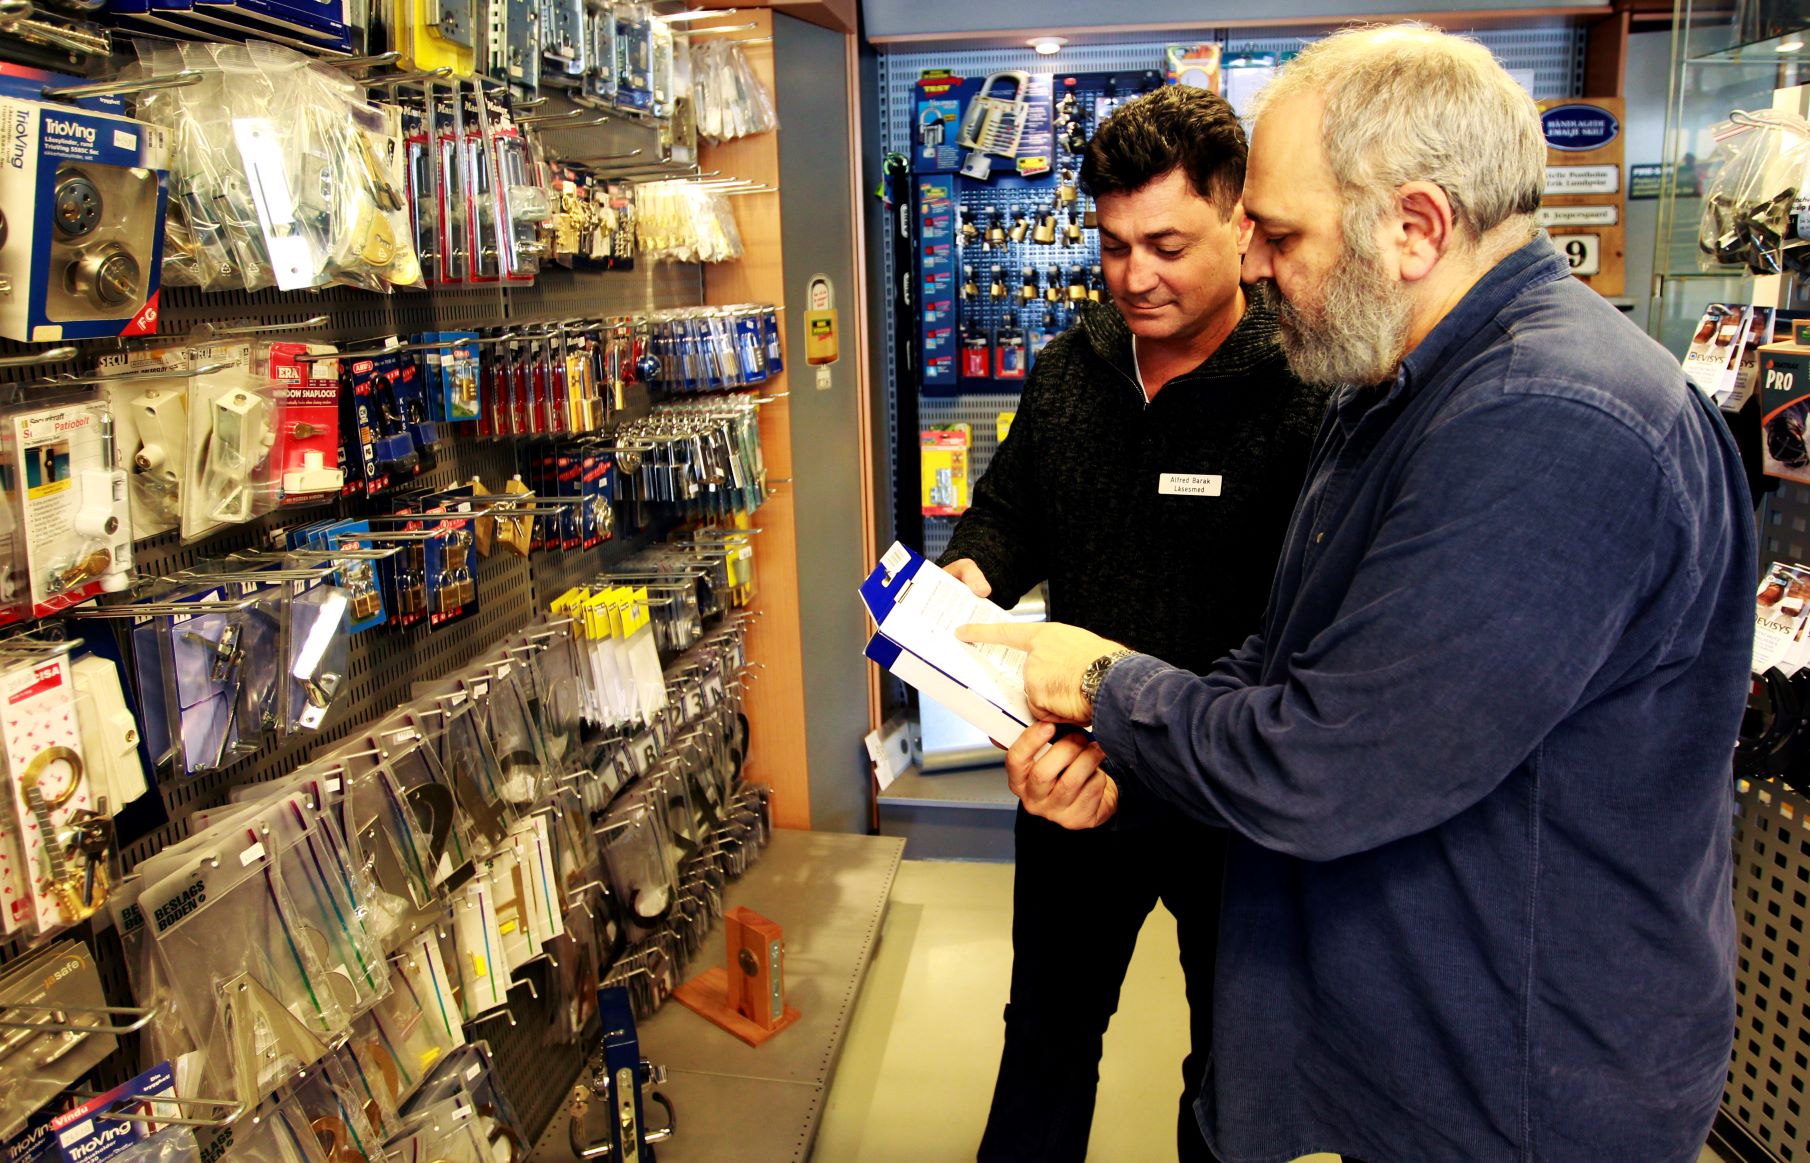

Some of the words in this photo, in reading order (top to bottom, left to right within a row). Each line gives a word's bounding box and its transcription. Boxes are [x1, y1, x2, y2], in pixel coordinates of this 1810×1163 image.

[11, 110, 29, 169] TrioVing
[45, 118, 96, 142] TrioVing
[1566, 240, 1587, 268] 9
[136, 307, 157, 331] FG
[1688, 352, 1726, 364] DEVISYS
[278, 367, 299, 379] ERA
[1765, 369, 1794, 391] PRO
[302, 389, 337, 398] SNAPLOCKS
[1170, 476, 1190, 484] Alfred
[154, 879, 205, 921] BESLAGS
[157, 899, 198, 932] BODEN
[54, 1105, 89, 1127] Vindu
[69, 1120, 131, 1160] TrioVing
[200, 1127, 233, 1159] SLAGS
